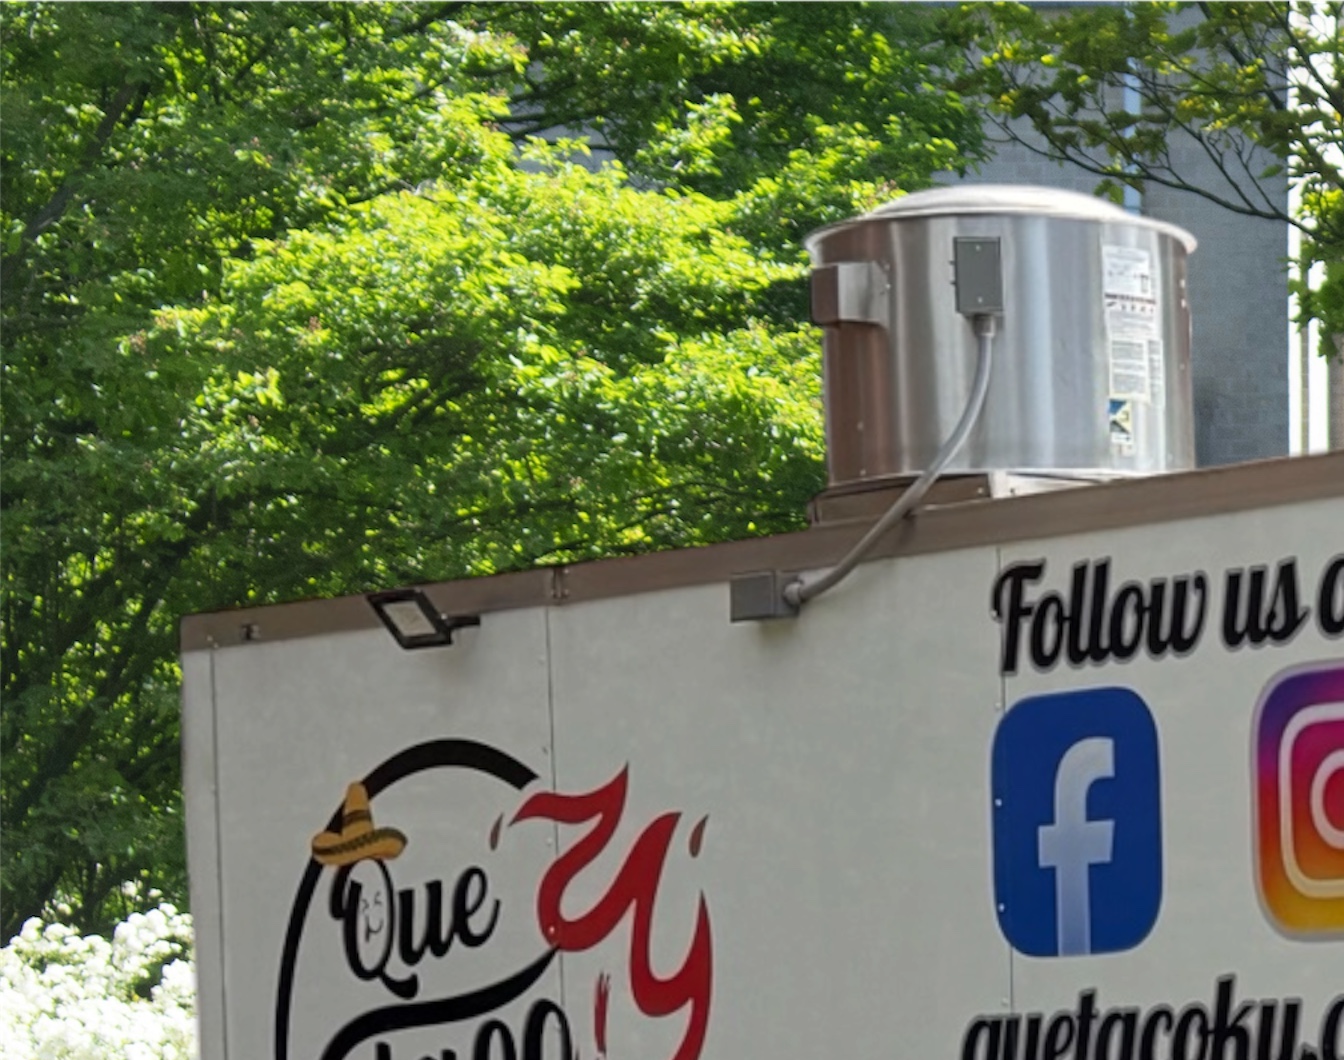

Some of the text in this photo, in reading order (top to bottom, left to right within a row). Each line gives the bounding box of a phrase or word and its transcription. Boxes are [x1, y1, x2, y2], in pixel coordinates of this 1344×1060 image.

[991, 556, 1207, 674] Follow
[1223, 557, 1307, 649] us
[329, 857, 502, 998] Que
